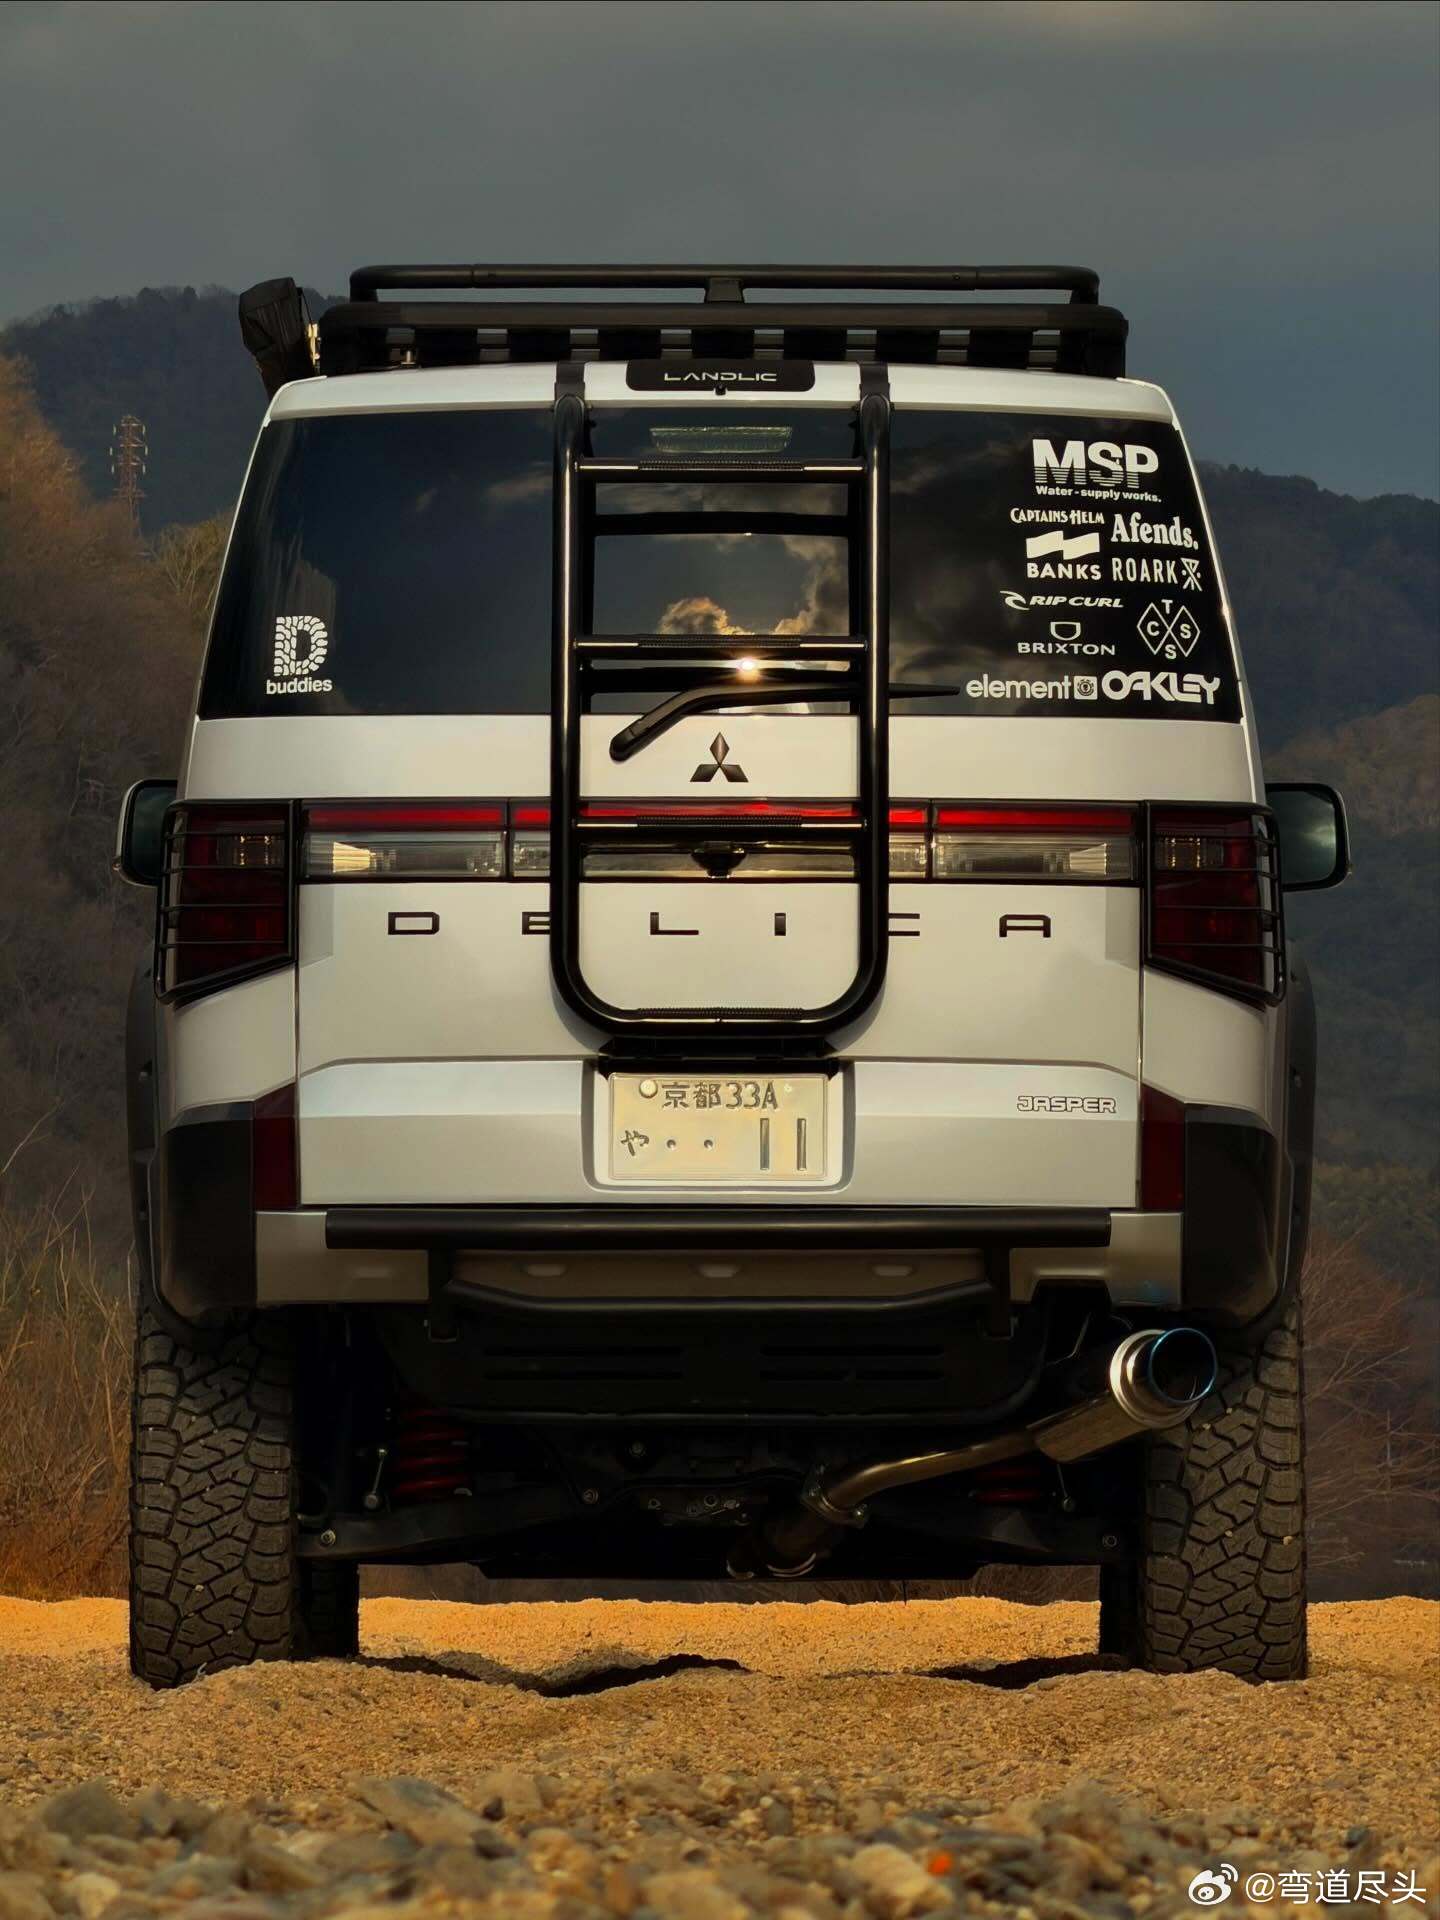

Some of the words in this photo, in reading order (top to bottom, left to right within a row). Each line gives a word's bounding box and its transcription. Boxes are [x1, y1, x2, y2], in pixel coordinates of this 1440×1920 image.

[664, 372, 777, 382] LANDLIC
[1032, 438, 1159, 489] MSP
[1122, 491, 1162, 503] works.
[1010, 507, 1069, 524] CAPTAINS
[1069, 509, 1105, 525] HELM
[1110, 511, 1199, 550] Afends.
[1026, 562, 1102, 581] BANKS
[1111, 557, 1178, 584] ROARK
[1029, 595, 1067, 606] RIP
[1068, 596, 1124, 608] CURL
[1017, 642, 1116, 656] BRIXTON
[266, 677, 333, 695] buddies
[965, 673, 1072, 700] element
[1101, 669, 1221, 705] OAKLEY
[1017, 1095, 1117, 1114] JASPER
